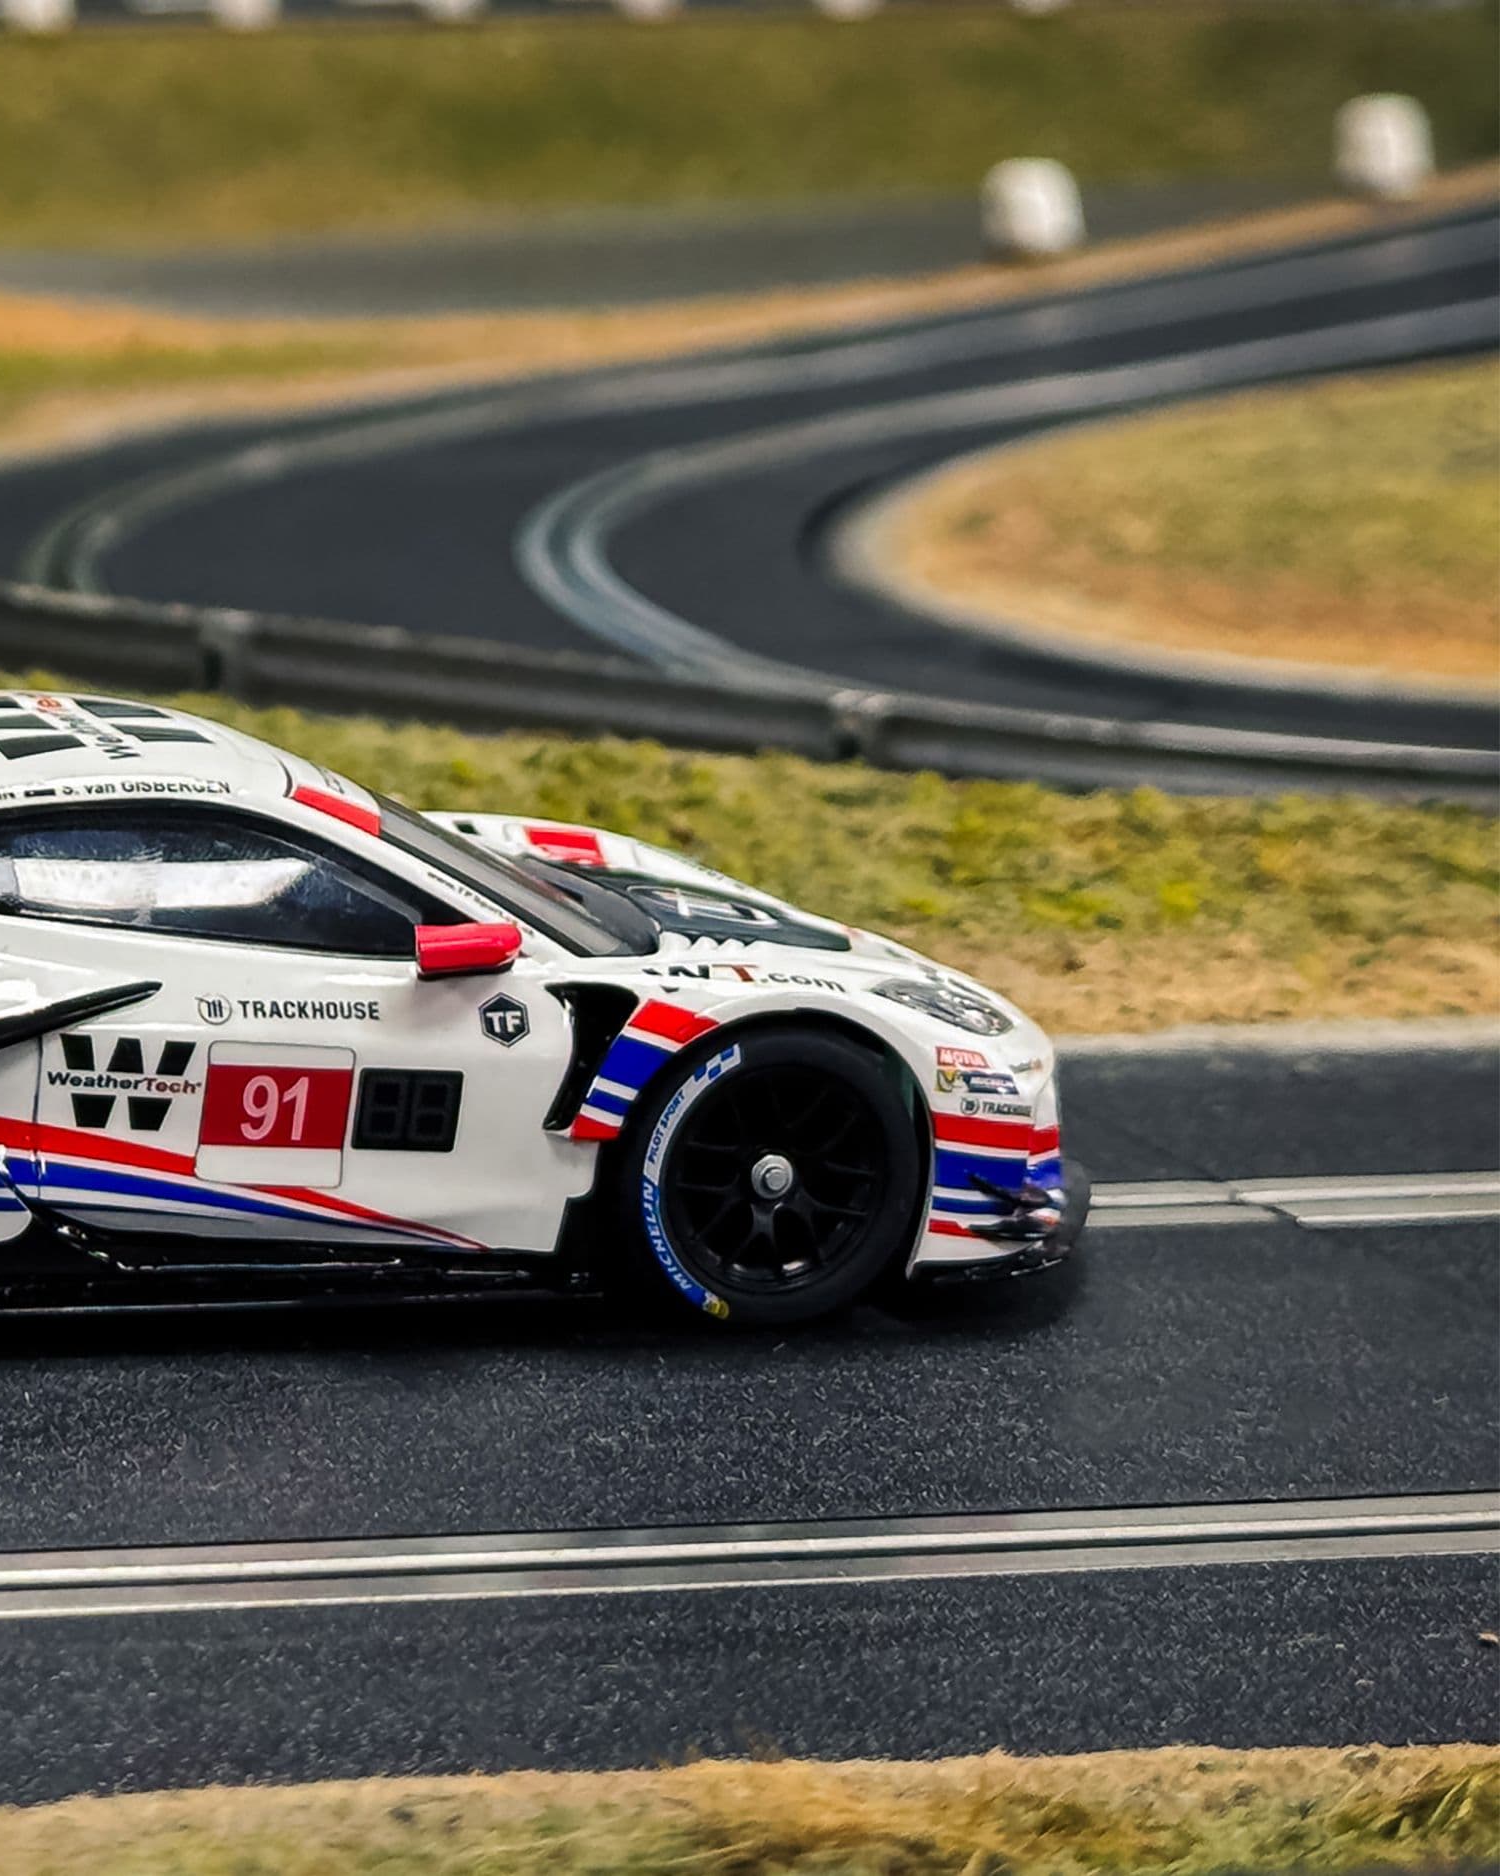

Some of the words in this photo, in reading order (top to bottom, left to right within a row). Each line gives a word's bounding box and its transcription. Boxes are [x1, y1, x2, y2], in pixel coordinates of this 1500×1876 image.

[86, 781, 116, 795] van
[238, 999, 381, 1021] TRACKHOUSE
[486, 1011, 523, 1034] TF
[47, 1070, 198, 1095] WeatherTech
[240, 1074, 309, 1141] 91
[647, 1130, 664, 1163] PILOT
[659, 1090, 686, 1129] SPORT
[643, 1181, 693, 1291] MICHELIN
